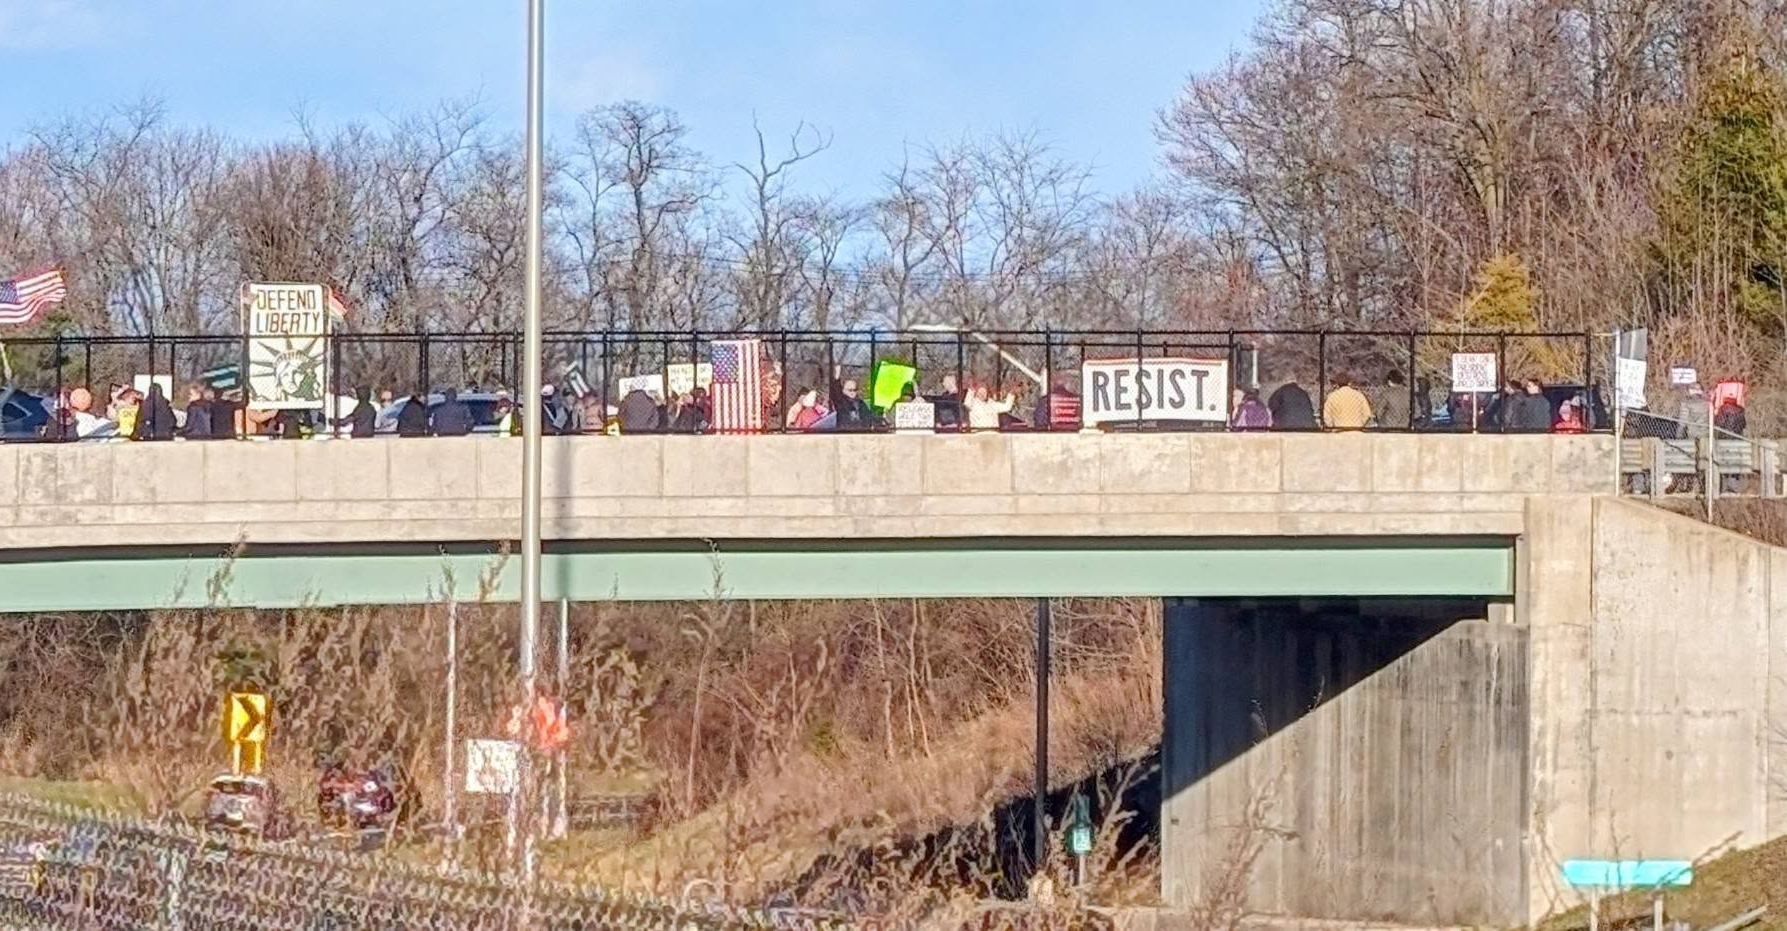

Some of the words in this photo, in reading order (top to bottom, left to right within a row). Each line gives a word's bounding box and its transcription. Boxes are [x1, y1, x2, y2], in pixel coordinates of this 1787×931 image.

[257, 289, 317, 310] DEFEND
[256, 312, 320, 333] LIBERTY
[1092, 369, 1216, 412] RESIST.
